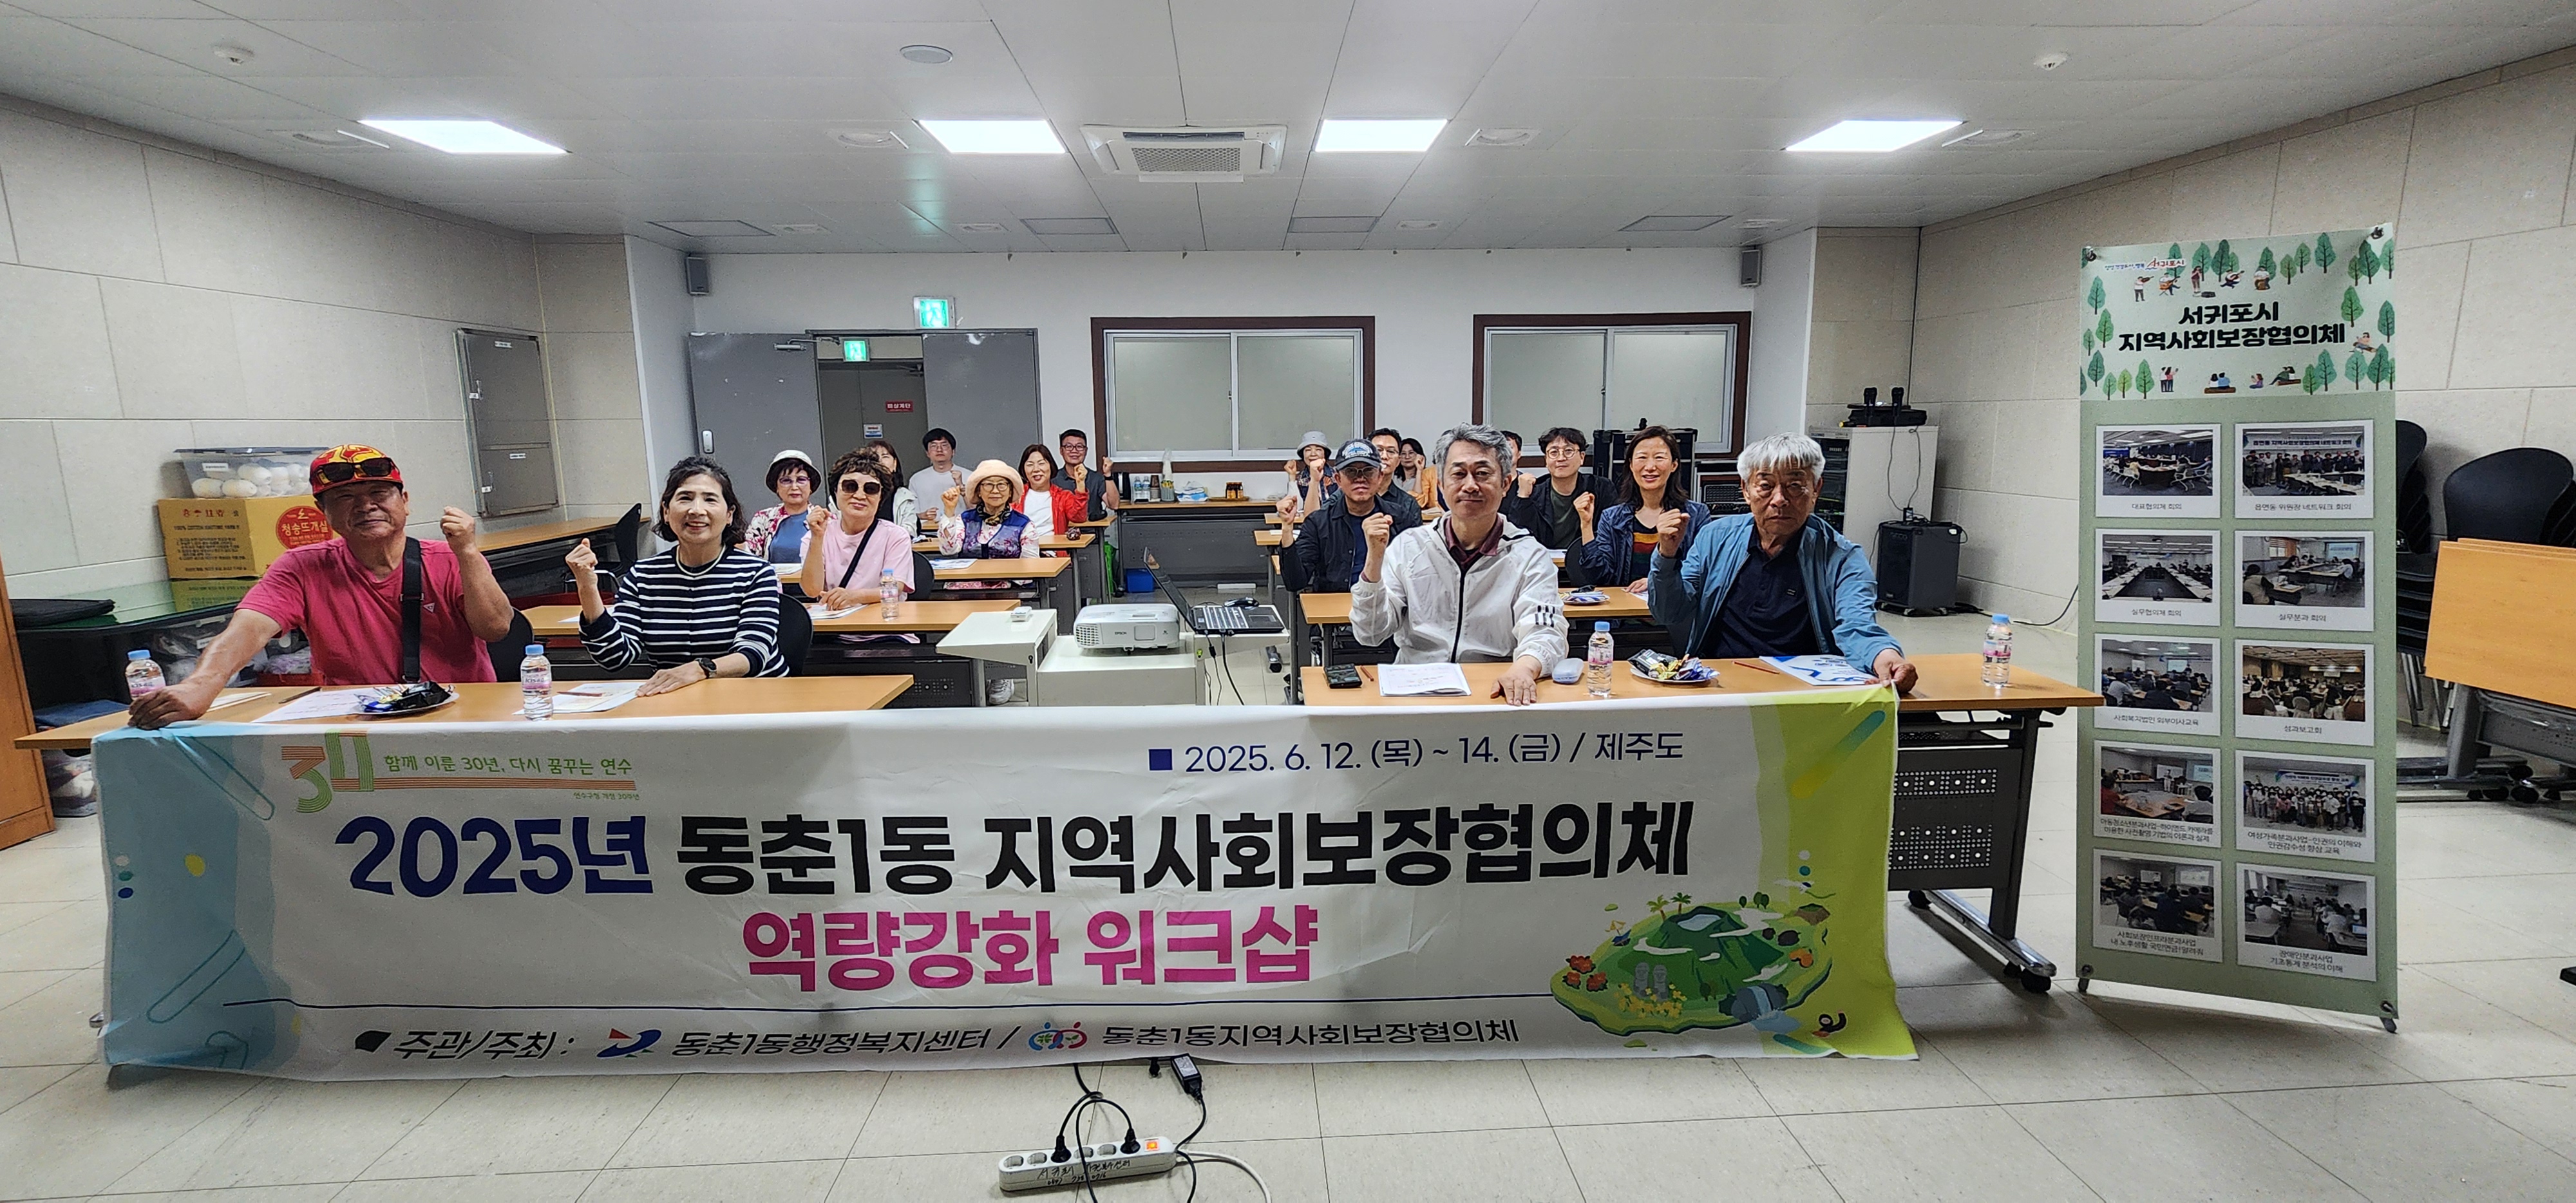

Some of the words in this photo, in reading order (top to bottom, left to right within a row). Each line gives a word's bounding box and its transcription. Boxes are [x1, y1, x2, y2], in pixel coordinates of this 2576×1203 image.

[2146, 258, 2184, 268] 서귀포시
[2179, 301, 2279, 324] 서귀포시
[2119, 323, 2345, 352] 지역사회보장협의체
[2132, 502, 2166, 511] 대표협의체
[2168, 502, 2183, 511] 회의
[2255, 502, 2277, 511] 읍면동
[2278, 502, 2301, 511] 위원장
[2302, 502, 2334, 511] 네트워크
[2335, 502, 2352, 511] 회의
[281, 520, 328, 536] 청송뜨개실
[2132, 608, 2166, 617] 실무협의체
[2168, 609, 2182, 618] 회의
[2279, 613, 2309, 622] 실무분과
[2311, 614, 2327, 622] 회의
[2114, 714, 2155, 725] 사회복지법인
[2157, 716, 2199, 726] 외부이사교육
[2284, 725, 2323, 734] 성과보고회
[1186, 745, 1276, 773] 2025.
[1284, 744, 1311, 772] 6.
[1321, 742, 1361, 770] 12.
[1372, 737, 1422, 768] (목)
[1458, 735, 1499, 764] 14.
[1509, 732, 1561, 763] (금)
[1570, 732, 1586, 764] /
[1594, 731, 1683, 761] 제주도
[384, 755, 417, 772] 함께
[424, 755, 457, 773] 이룬
[463, 756, 506, 775] 30년,
[510, 756, 542, 774] 다시
[547, 757, 594, 775] 꿈꾸는
[600, 758, 632, 775] 연수
[335, 815, 654, 898] 2025년
[677, 813, 955, 895] 동춘1동
[984, 801, 1695, 894] 지역사회보장협의체
[2268, 841, 2306, 852] 인권감수성
[2307, 845, 2322, 853] 향상
[2324, 847, 2340, 855] 교육
[2337, 840, 2362, 848] 이해와
[743, 909, 1059, 992] 역량강화
[1084, 904, 1319, 986] 워크샵
[2280, 951, 2333, 963] 장애인분과사업
[2270, 957, 2300, 968] 기초통계
[2327, 965, 2344, 973] 이해
[673, 1030, 992, 1056] 동춘1동행정복지센터
[997, 1025, 1022, 1050] /
[1102, 1019, 1520, 1048] 동춘1동지역사회보장협의체
